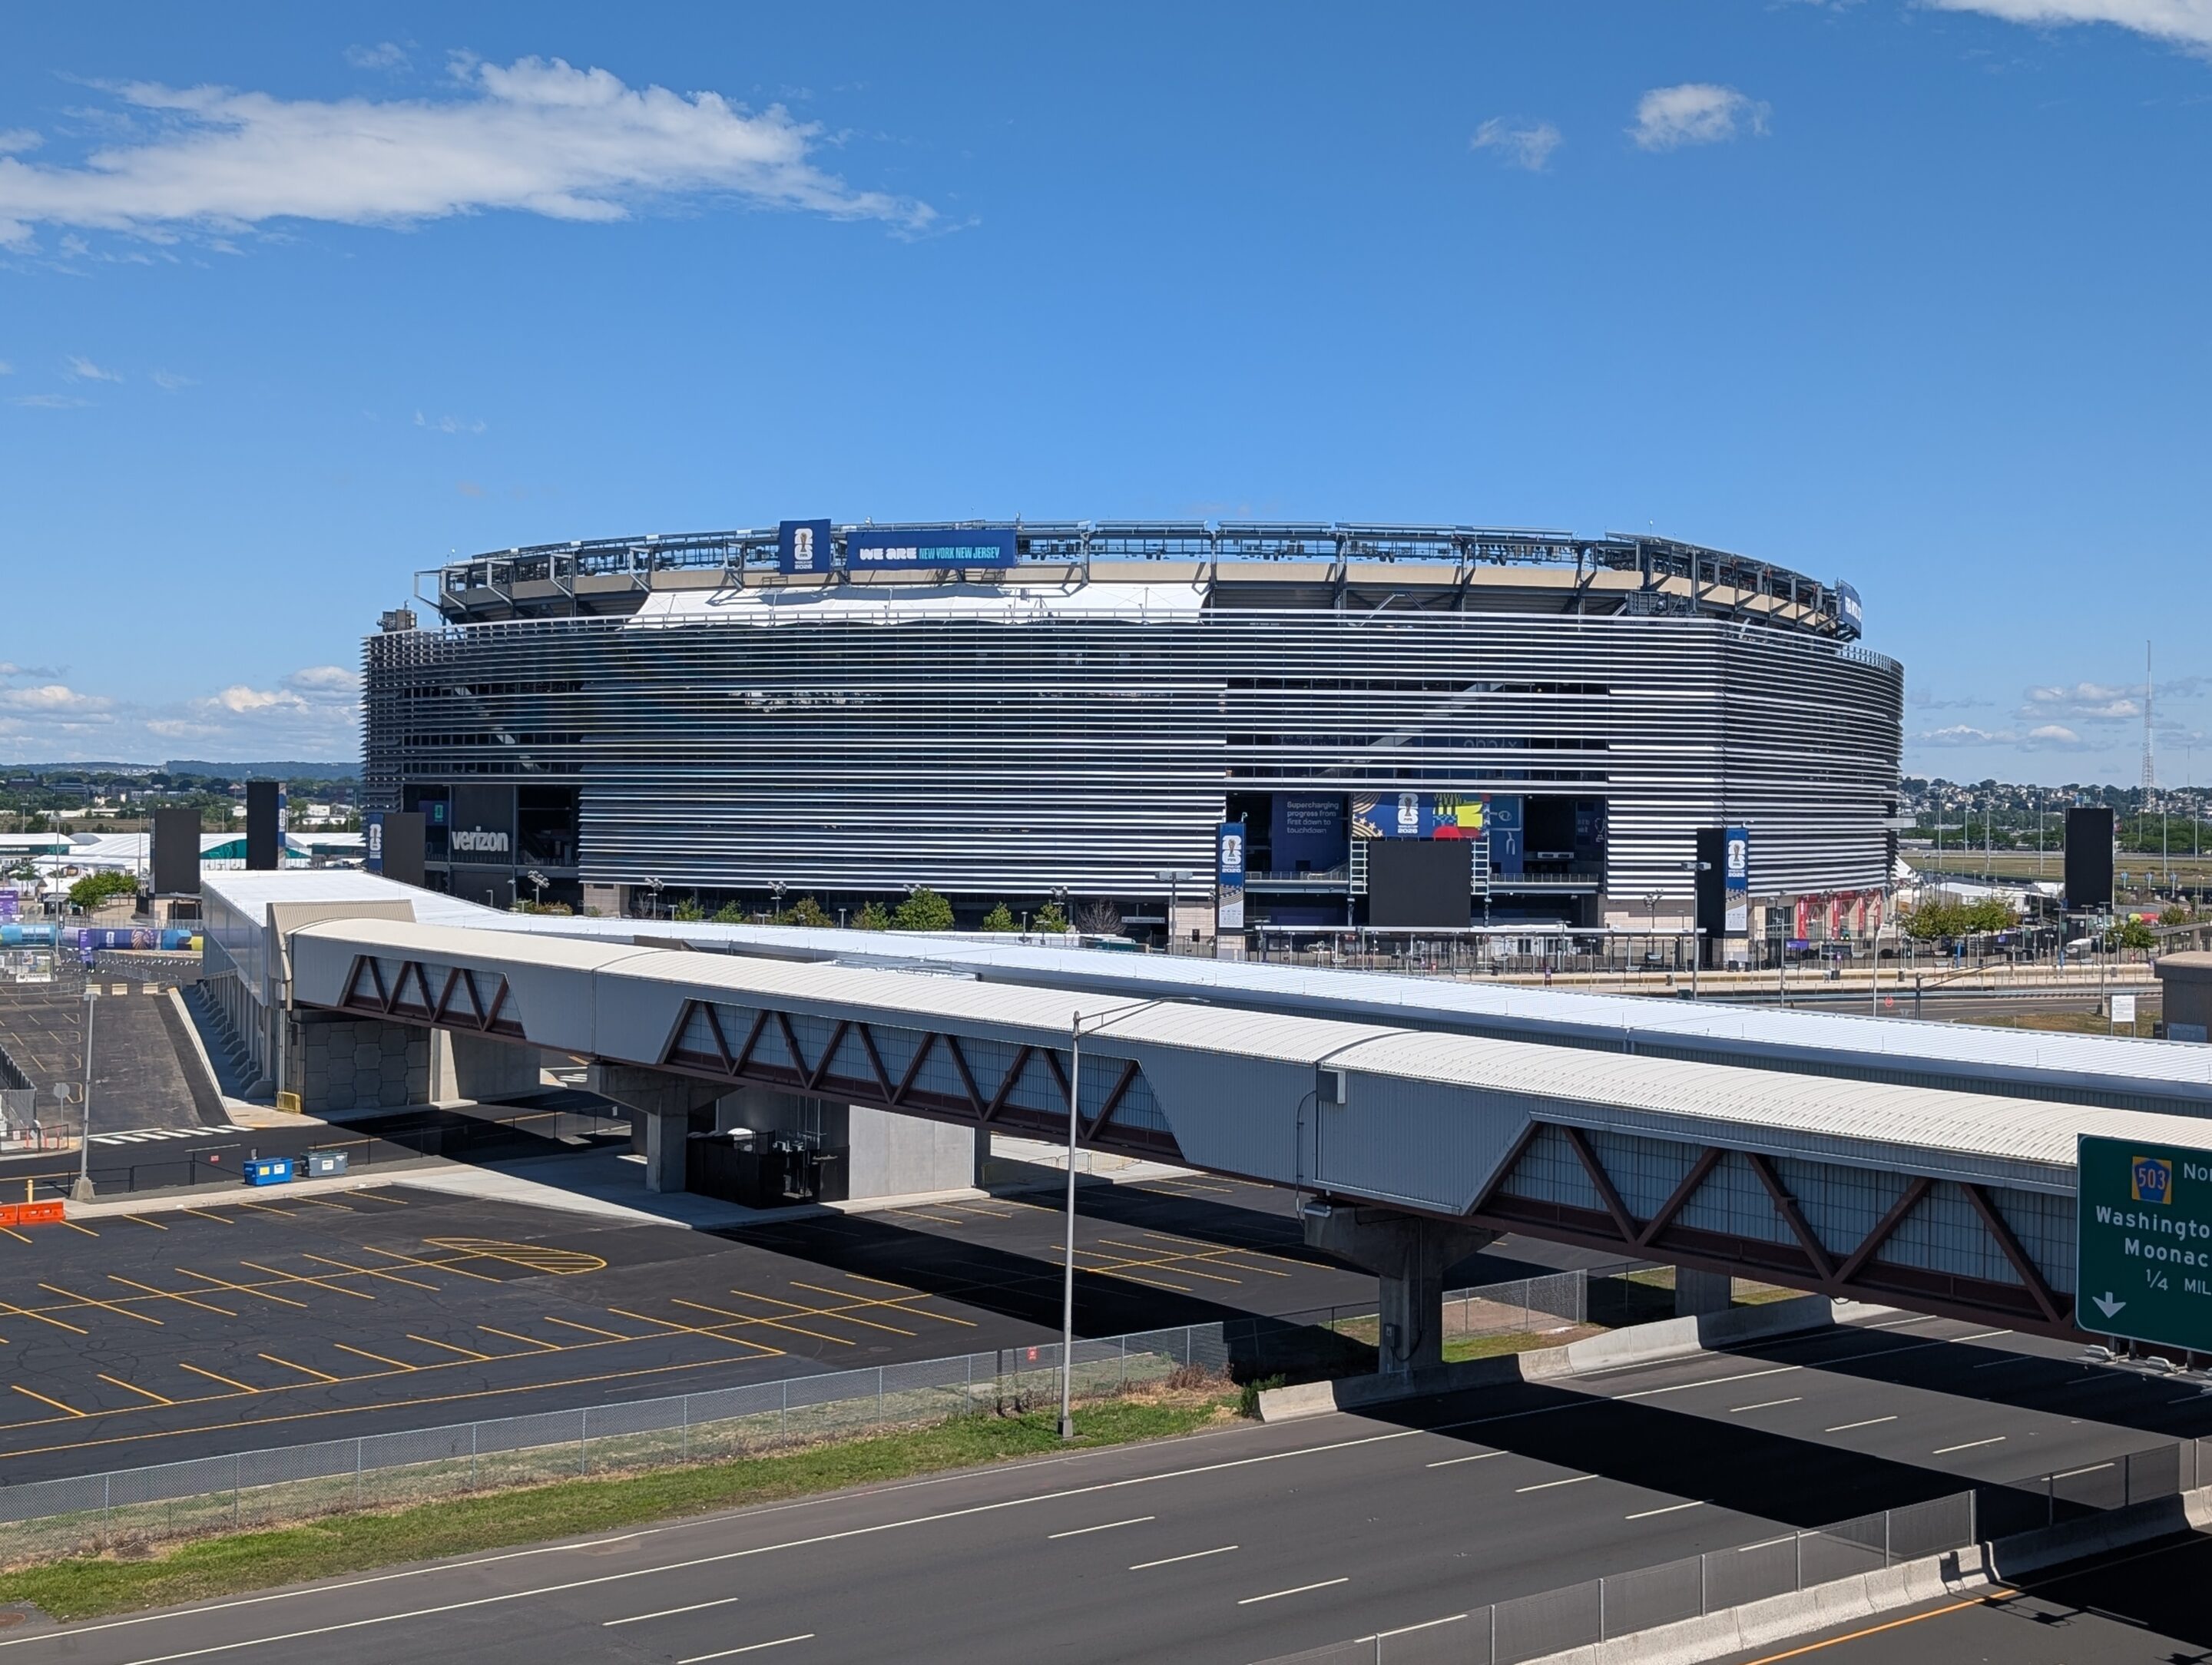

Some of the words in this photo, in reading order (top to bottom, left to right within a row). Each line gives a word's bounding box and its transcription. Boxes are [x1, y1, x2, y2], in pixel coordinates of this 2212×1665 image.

[859, 548, 884, 561] WE
[886, 547, 917, 560] ARE
[919, 548, 935, 560] NEW
[935, 547, 955, 559] YORK
[955, 547, 972, 559] NEW
[973, 547, 1000, 559] JERSEY
[1286, 801, 1339, 809] Supercharging
[452, 826, 508, 852] verizon
[2138, 1167, 2166, 1190] 503
[2095, 1205, 2210, 1241] Washingto
[2124, 1237, 2209, 1268] Moonac
[2184, 1278, 2212, 1296] MIL
